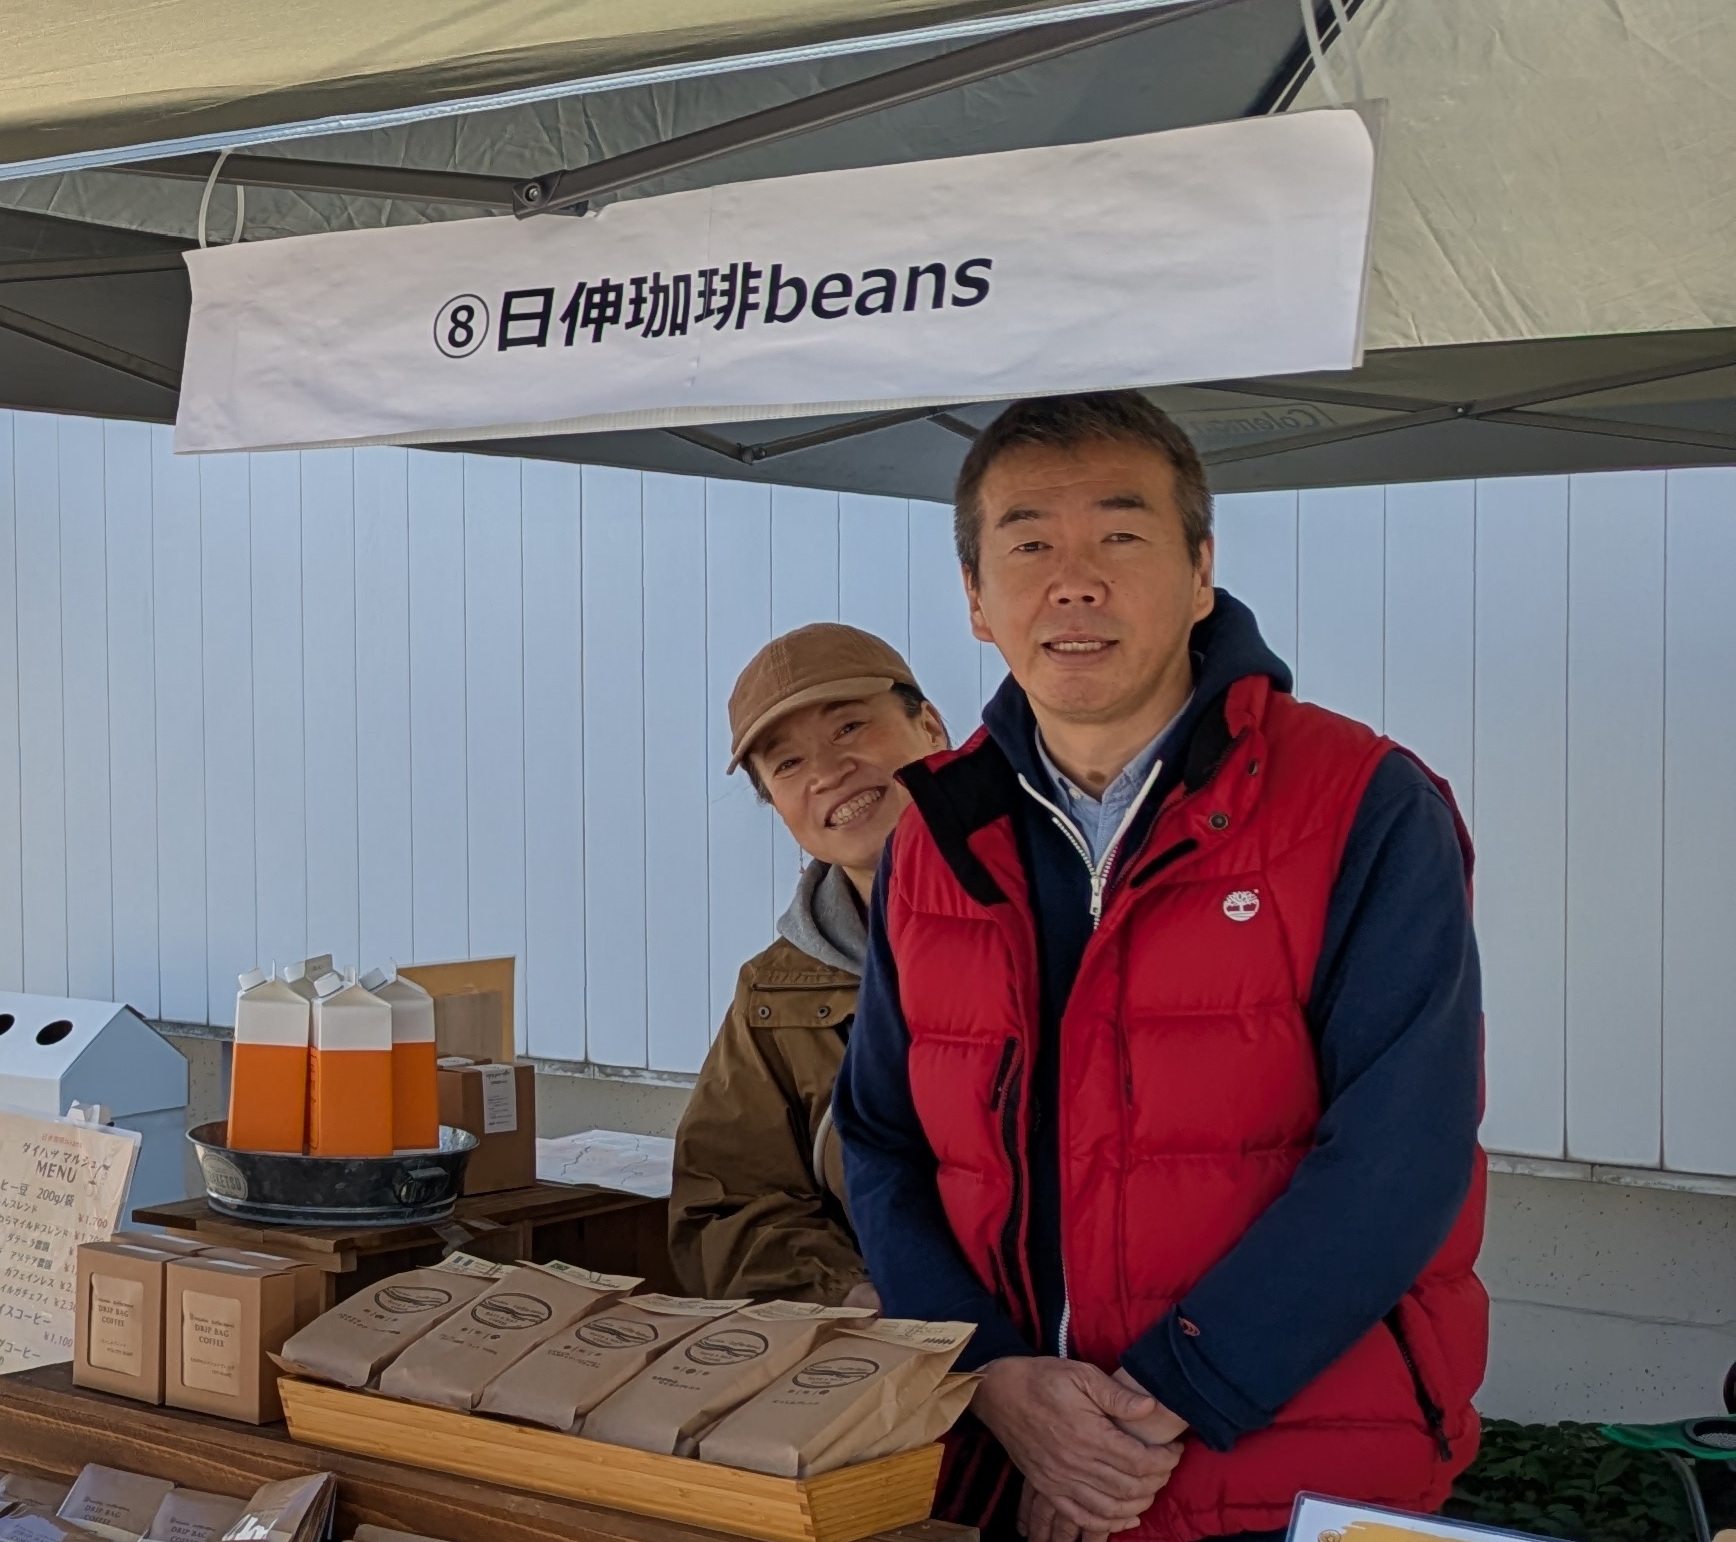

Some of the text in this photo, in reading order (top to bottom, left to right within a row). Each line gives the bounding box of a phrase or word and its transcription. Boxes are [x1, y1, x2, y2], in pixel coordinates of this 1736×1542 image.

[433, 258, 993, 359] ⑧日伸珈琲beans
[35, 1160, 78, 1184] MENU
[4, 1266, 55, 1289] カフェインレス
[43, 1330, 74, 1348] ¥1,100
